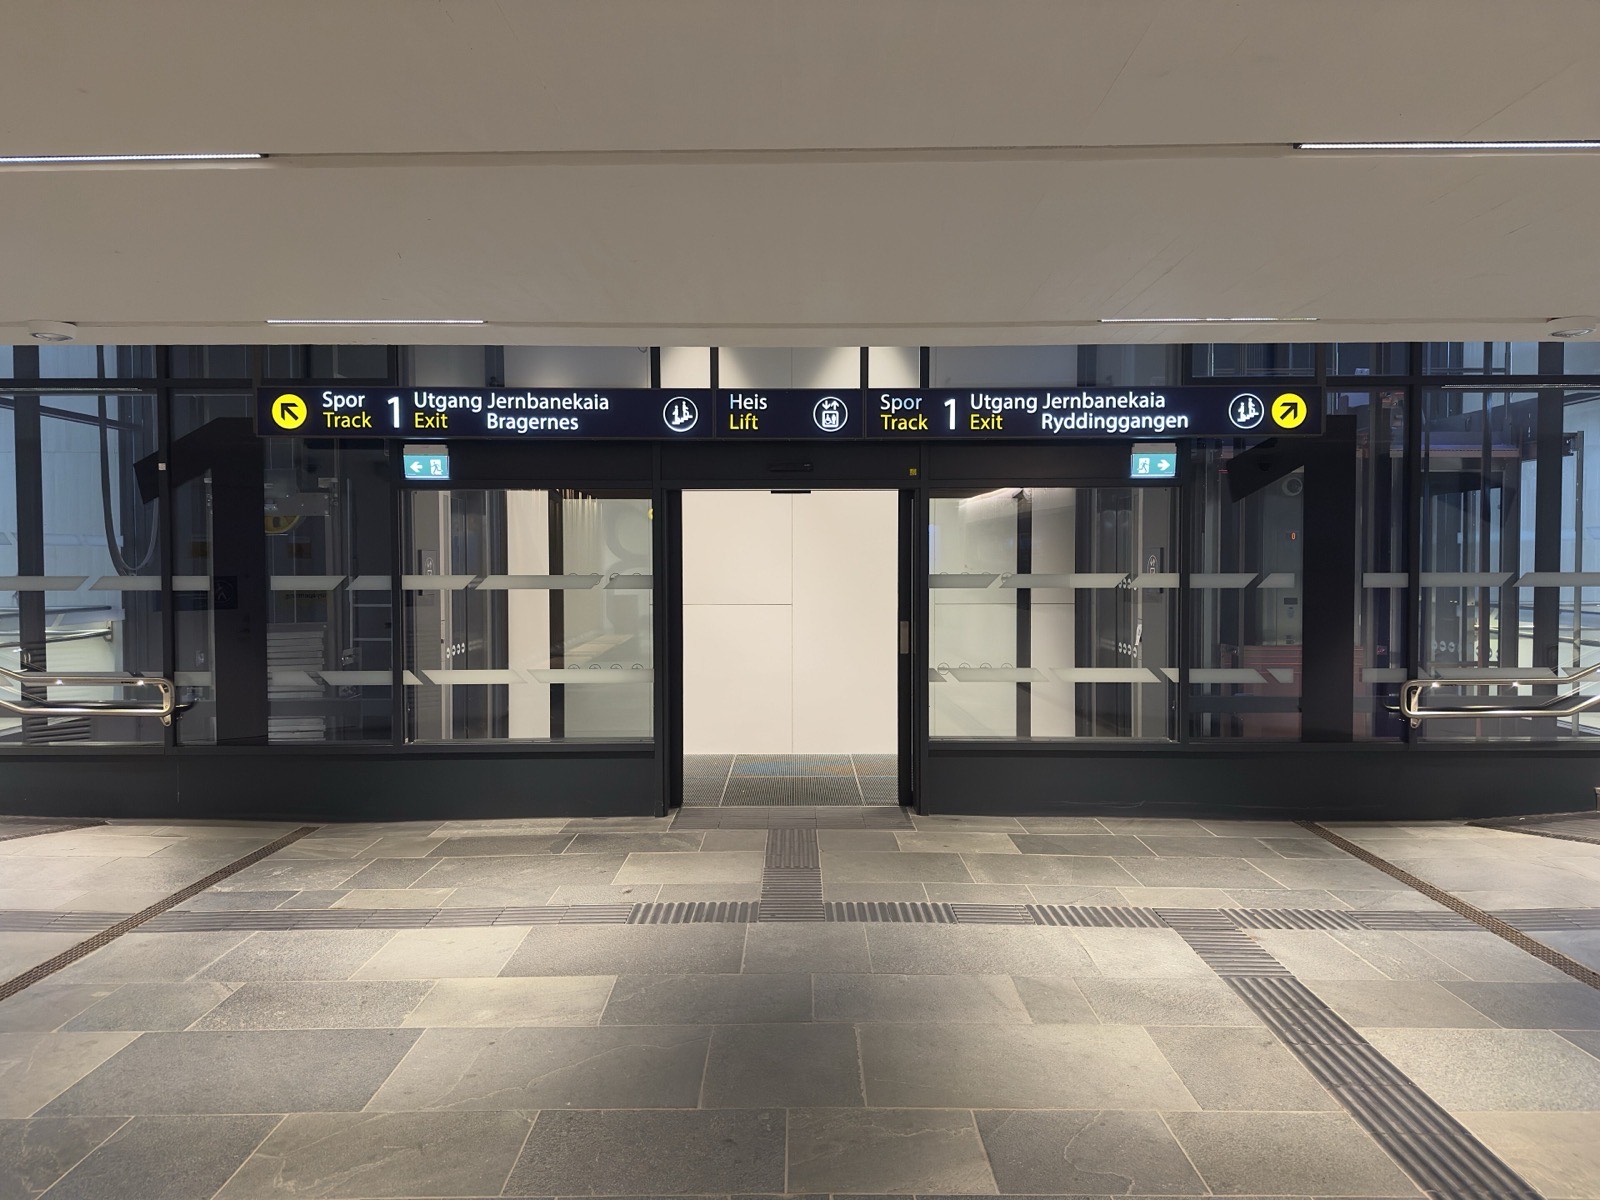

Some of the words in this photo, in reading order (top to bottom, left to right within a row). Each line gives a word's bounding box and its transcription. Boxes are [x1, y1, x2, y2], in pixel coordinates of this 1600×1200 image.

[322, 391, 366, 412] Spor
[413, 391, 482, 413] Utgang
[487, 391, 609, 411] Jernbanekaia
[729, 394, 768, 411] Heis
[880, 393, 922, 413] Spor
[970, 393, 1038, 413] Utgang
[1041, 391, 1166, 411] Jernbanekaia
[322, 411, 373, 429] Track
[387, 396, 401, 429] 1
[414, 411, 449, 429] Exit
[486, 411, 579, 433] Bragernes
[729, 412, 759, 430] Lift
[881, 412, 929, 430] Track
[943, 398, 956, 430] 1
[970, 412, 1004, 430] Exit
[1041, 412, 1189, 434] Ryddinggangen
